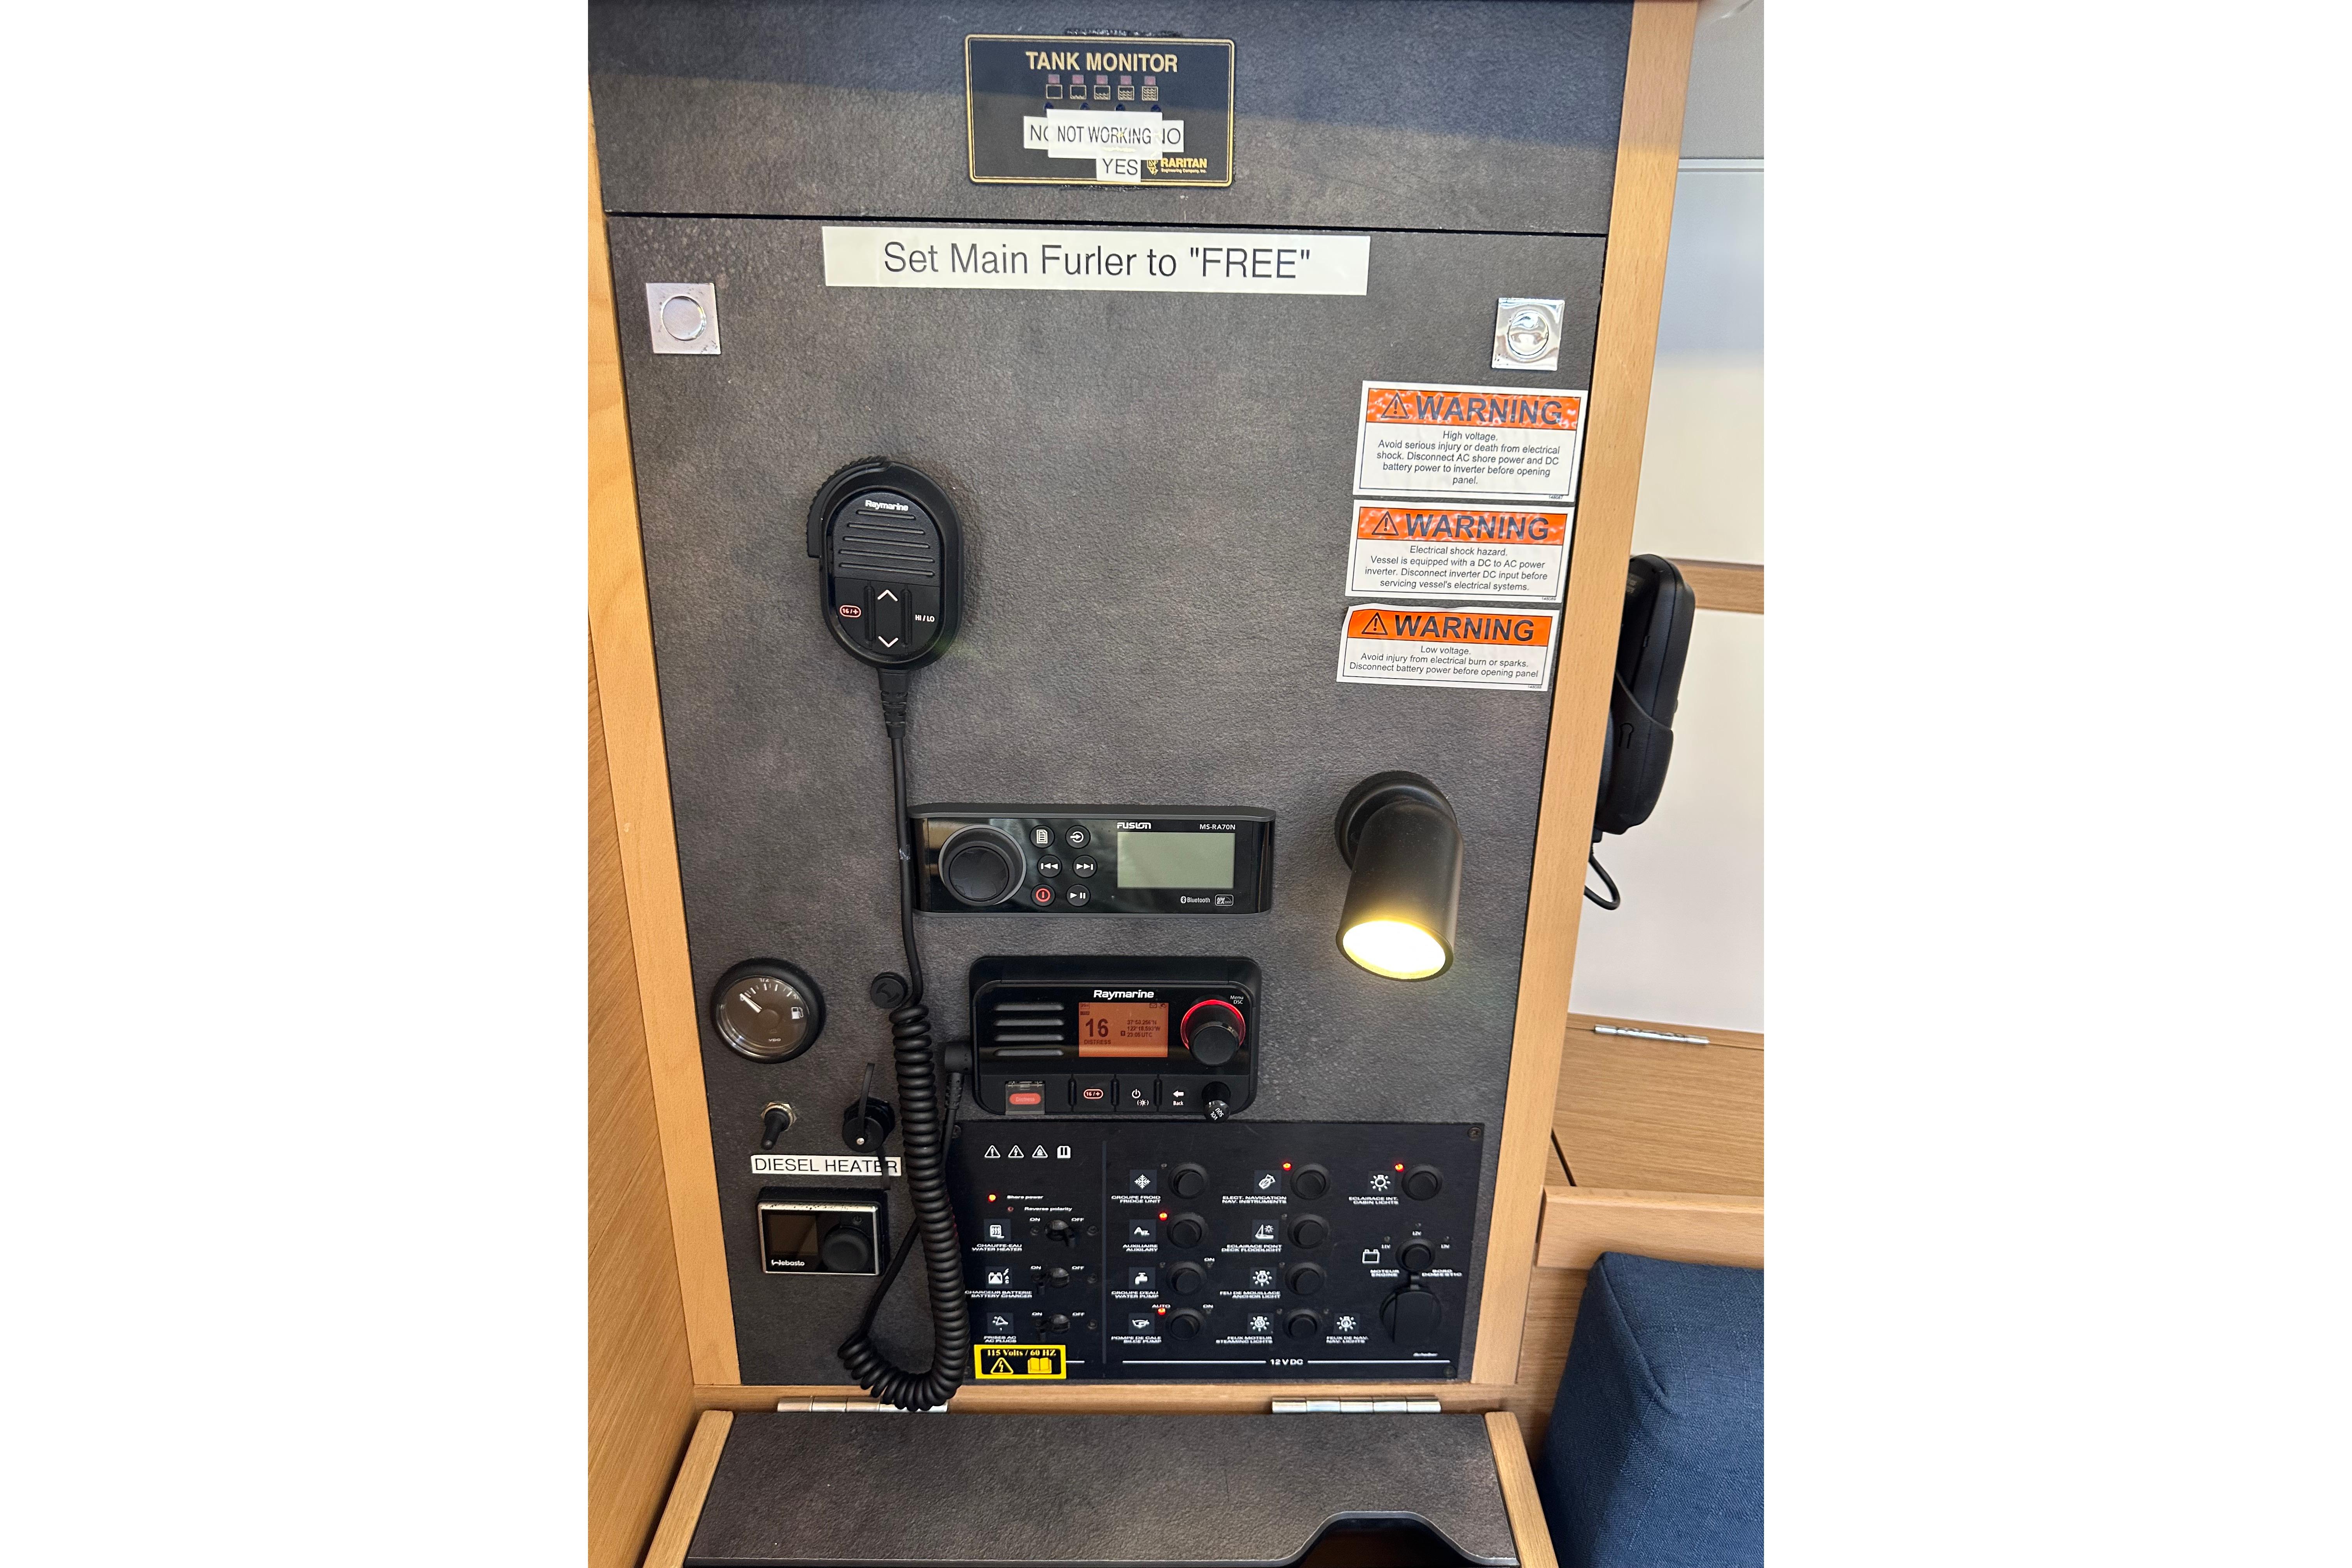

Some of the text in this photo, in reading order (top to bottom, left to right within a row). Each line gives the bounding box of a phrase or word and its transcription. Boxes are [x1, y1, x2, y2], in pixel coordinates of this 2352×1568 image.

[1026, 51, 1178, 72] TANK MONITOR
[1058, 126, 1151, 144] NOT WORKING
[1102, 158, 1138, 175] YES
[1160, 158, 1207, 168] RARITAN
[884, 242, 1310, 279] Set Main Furler to "FREE"
[1416, 395, 1562, 425] WARNING
[1443, 431, 1498, 442] High voltage.
[1378, 439, 1402, 450] Avoid
[1405, 441, 1435, 450] serious
[1438, 442, 1461, 452] injury
[1475, 443, 1498, 452] death
[1501, 444, 1519, 453] from
[1522, 445, 1559, 455] electrical
[1377, 451, 1559, 465] shock. Disconnect AC shore power and DC
[1383, 463, 1550, 478] battery power to inverter before opening
[1452, 476, 1478, 486] panel.
[865, 500, 909, 511] Raymarine
[1406, 513, 1549, 541] WARNING
[1410, 545, 1507, 556] Electrical shock hazard.
[1371, 556, 1398, 565] Vessel
[1401, 556, 1407, 565] is
[1410, 557, 1448, 567] equipped
[1451, 558, 1467, 567] with
[1478, 559, 1491, 567] DC
[1504, 560, 1517, 568] AC
[1365, 567, 1547, 580] inverter. Disconnect inverter DC input before
[1380, 579, 1529, 592] servicing vessel's electrical systems.
[1395, 614, 1534, 642] WARNING
[1421, 646, 1470, 656] Low voltage.
[1361, 653, 1383, 662] Avoid
[1386, 654, 1408, 663] injury
[1410, 655, 1428, 663] from
[1430, 656, 1466, 665] electrical
[1468, 657, 1486, 665] burn
[1500, 658, 1528, 668] sparks.
[1350, 662, 1538, 678] Disconnect battery power before opening panel
[1094, 989, 1154, 1000] Raymarine
[1085, 1018, 1108, 1037] 16
[755, 1158, 898, 1172] DIESEL HEATER
